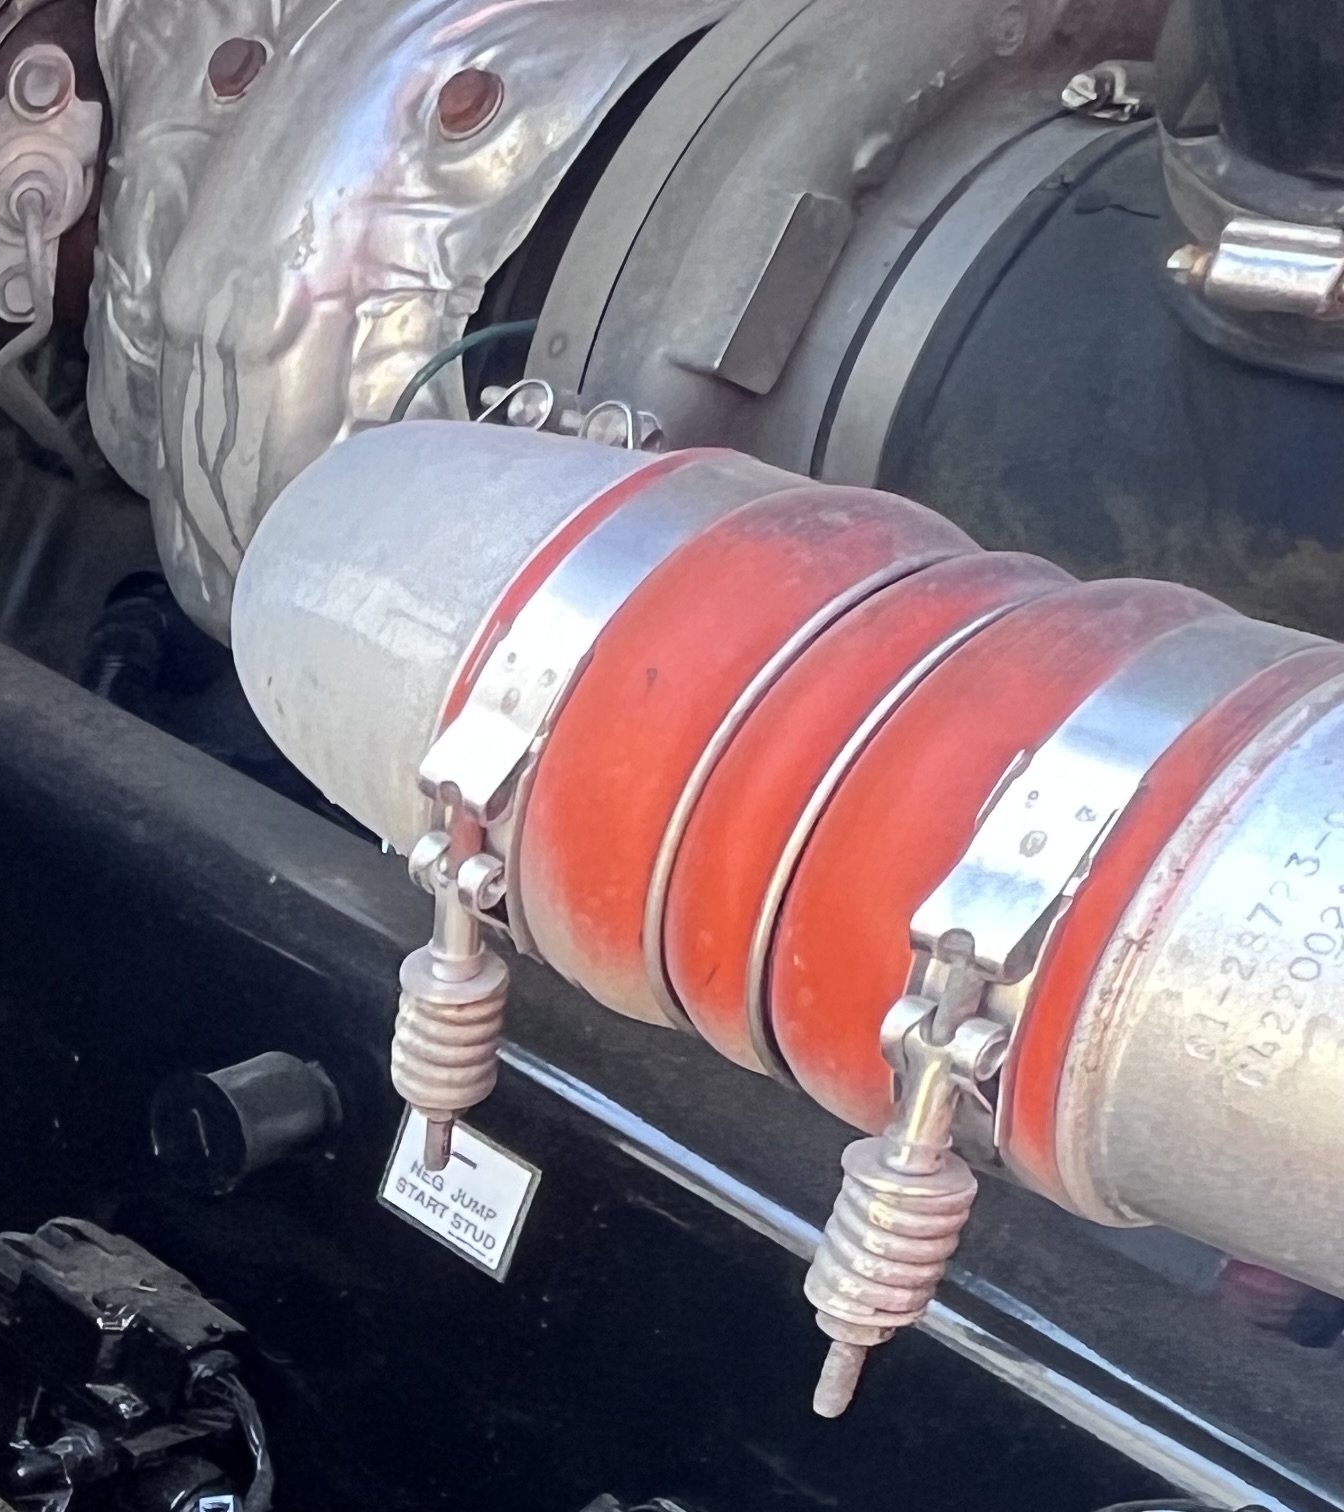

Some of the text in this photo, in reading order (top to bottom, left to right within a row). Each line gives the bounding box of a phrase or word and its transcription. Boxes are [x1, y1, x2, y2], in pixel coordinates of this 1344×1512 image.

[396, 1177, 449, 1218] START
[451, 1213, 495, 1250] STUD
[411, 1160, 497, 1221] NEG JUMP
